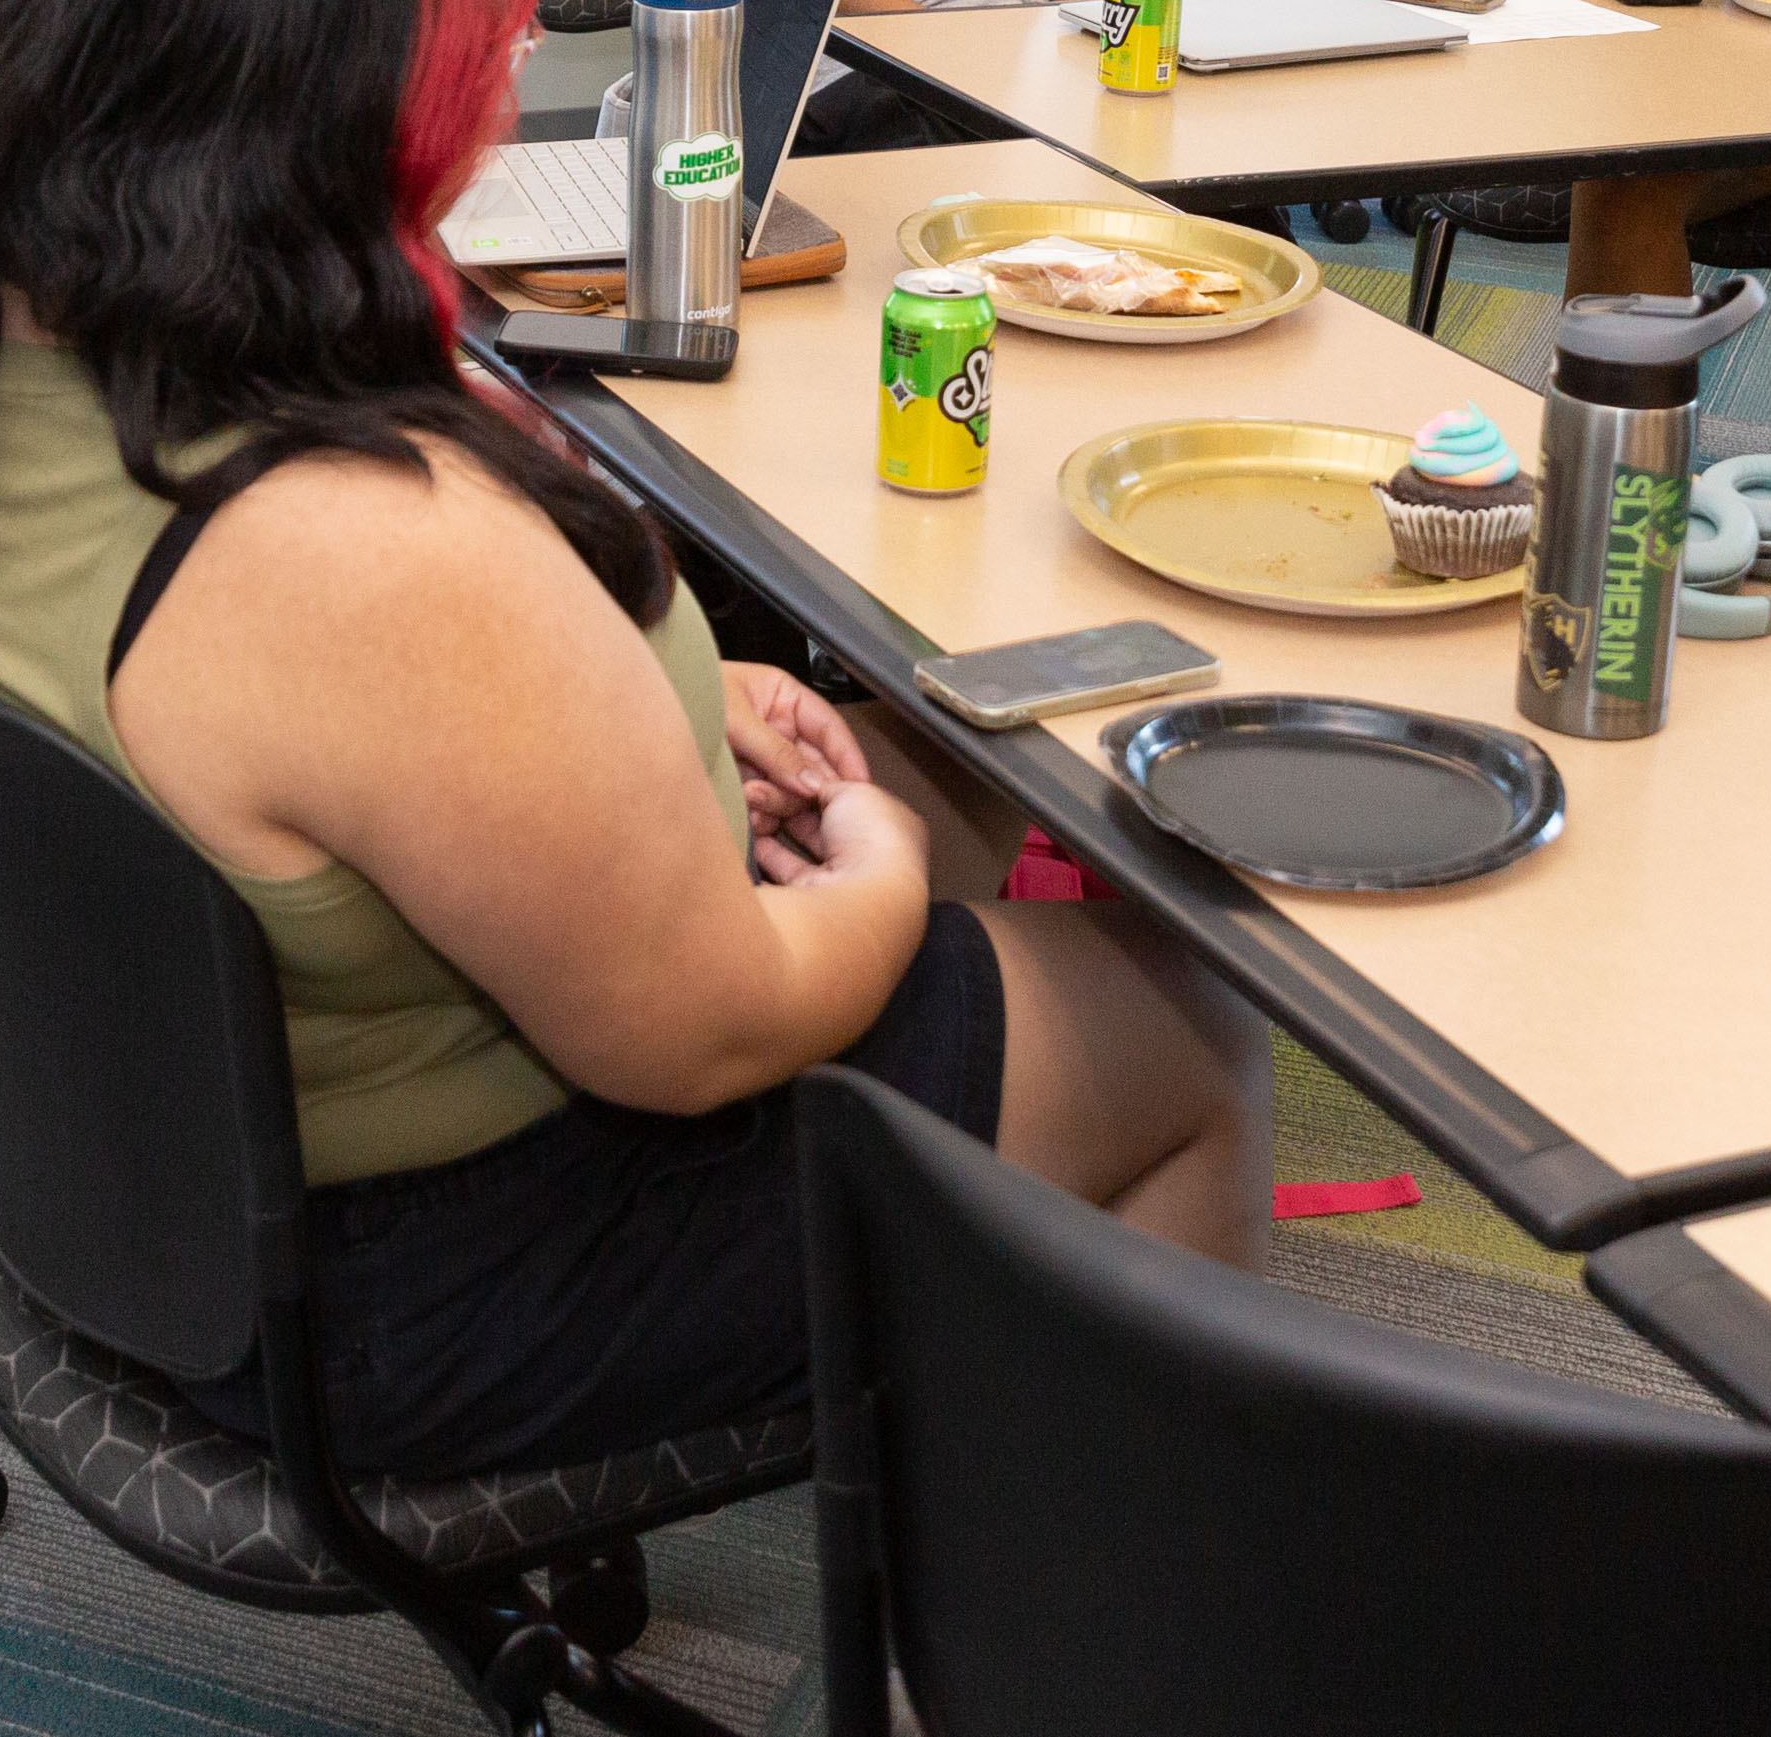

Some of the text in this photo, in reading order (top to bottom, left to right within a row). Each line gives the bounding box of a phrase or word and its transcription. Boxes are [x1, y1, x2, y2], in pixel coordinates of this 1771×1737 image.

[663, 156, 741, 185] EDUCATION
[679, 143, 735, 169] HIGHER
[1594, 474, 1654, 682] SLYTHERIN
